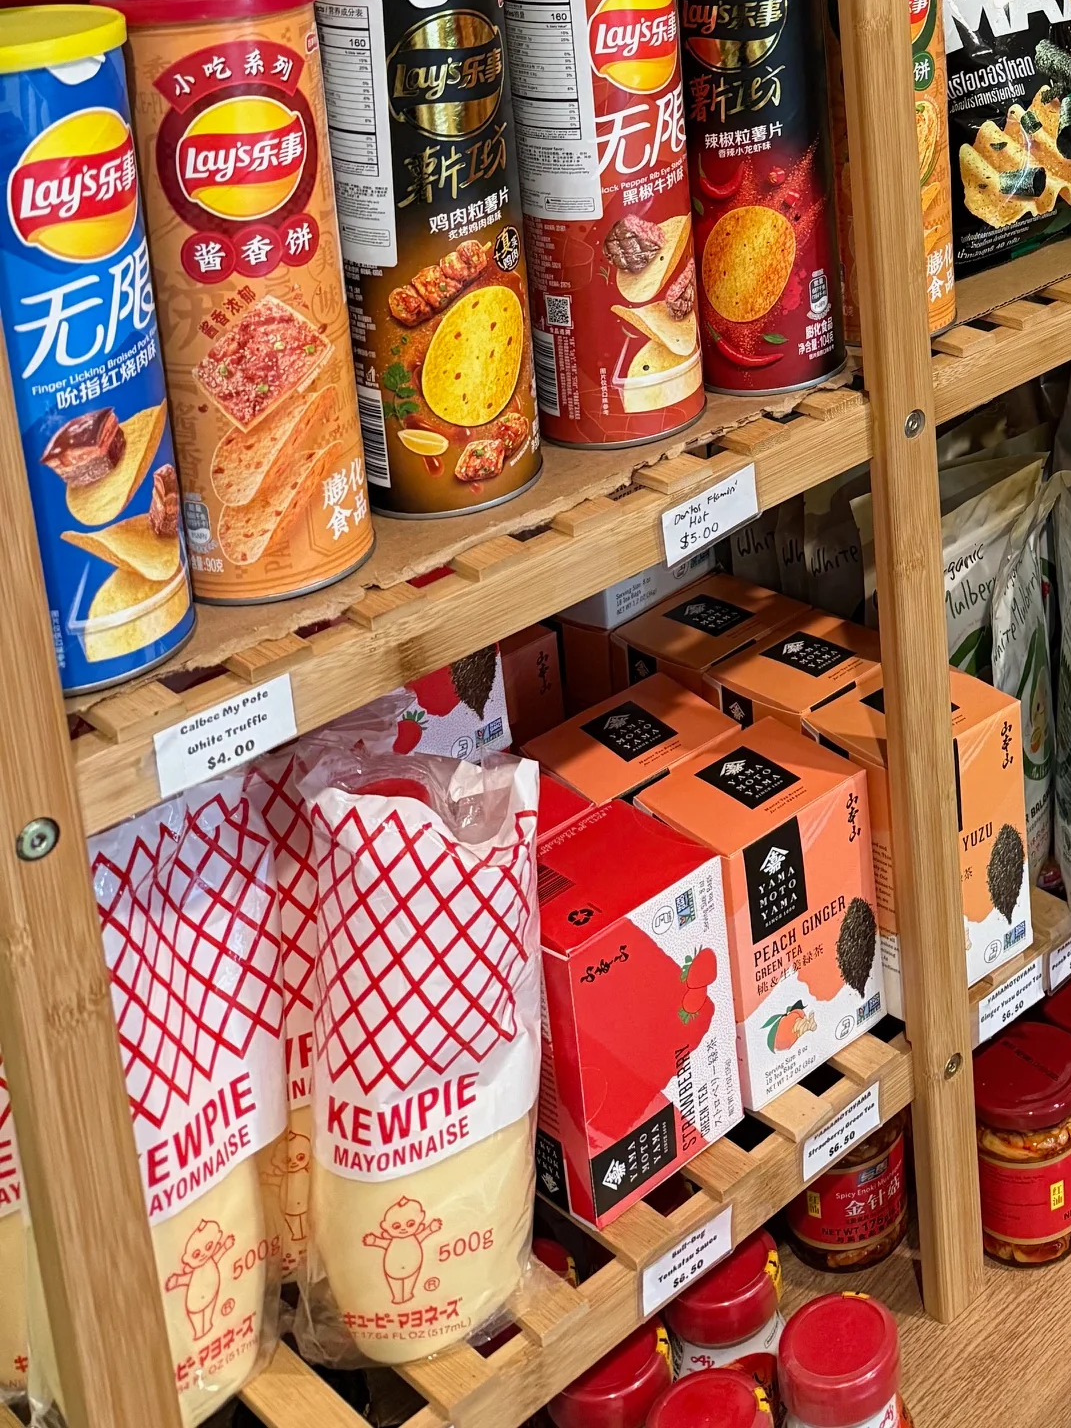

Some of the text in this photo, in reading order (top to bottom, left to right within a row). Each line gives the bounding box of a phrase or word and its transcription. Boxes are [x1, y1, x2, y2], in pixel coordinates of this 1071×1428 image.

[550, 12, 567, 21] 160
[349, 38, 366, 47] 160
[173, 50, 293, 97] 小吃系列
[594, 82, 686, 174] 无限
[705, 122, 784, 149] 辣椒粒薯片
[718, 143, 772, 159] 香辣小龙虾味
[621, 176, 647, 190] Pepper
[623, 166, 684, 205] 黑椒牛扒味
[429, 186, 509, 235] 鸡肉粒薯片
[195, 225, 313, 272] 酱香饼
[14, 254, 154, 379] 无限
[199, 285, 257, 339] 酱香浓郁
[806, 318, 833, 340] 膨化食品
[32, 347, 137, 397] Finger Licking Braised
[57, 345, 157, 410] 吮指红烧肉味
[323, 456, 364, 506] 膨化
[326, 493, 368, 541] 食品
[689, 511, 709, 527] Hot
[679, 523, 719, 550] $5.00
[790, 642, 821, 661] YAMA
[799, 646, 829, 664] MOTO
[807, 650, 838, 668] YAMA
[180, 689, 269, 736] Calbee My Pote
[187, 712, 268, 756] White Truffle
[609, 719, 645, 740] YAMA
[615, 723, 653, 746] MOTO
[623, 729, 660, 750] YAMA
[207, 739, 256, 771] $4.00
[728, 764, 763, 786] YAMA
[735, 768, 772, 793] MOTO
[744, 774, 781, 796] YAMA
[961, 821, 994, 852] YUZU
[758, 866, 795, 894] YAMA
[759, 879, 797, 908] MOTO
[760, 892, 798, 920] YAMA
[754, 895, 847, 967] PEACH GINGER
[755, 944, 803, 982] GREEN TEA
[980, 1005, 1000, 1023] Ginger
[1001, 1000, 1024, 1022] $6.50
[327, 1072, 480, 1147] KEWPIE
[674, 1043, 699, 1152] STRAWBERRY
[146, 1072, 257, 1189] EWPIE
[699, 1105, 712, 1141] GREEN
[808, 1112, 864, 1159] Strawberry Green
[333, 1115, 470, 1173] MAYONNAISE
[829, 1131, 855, 1158] $6.50
[149, 1123, 252, 1217] AYONNAISE
[836, 1190, 856, 1200] Spicy
[845, 1174, 900, 1217] 金针菇
[232, 1233, 282, 1281] 500g
[438, 1228, 494, 1263] 500g
[658, 1235, 718, 1284] Tonkatsu Sauce
[671, 1228, 706, 1259] Bull-Dog
[672, 1258, 705, 1289] $6.50
[400, 1296, 463, 1328] マヨネーズ
